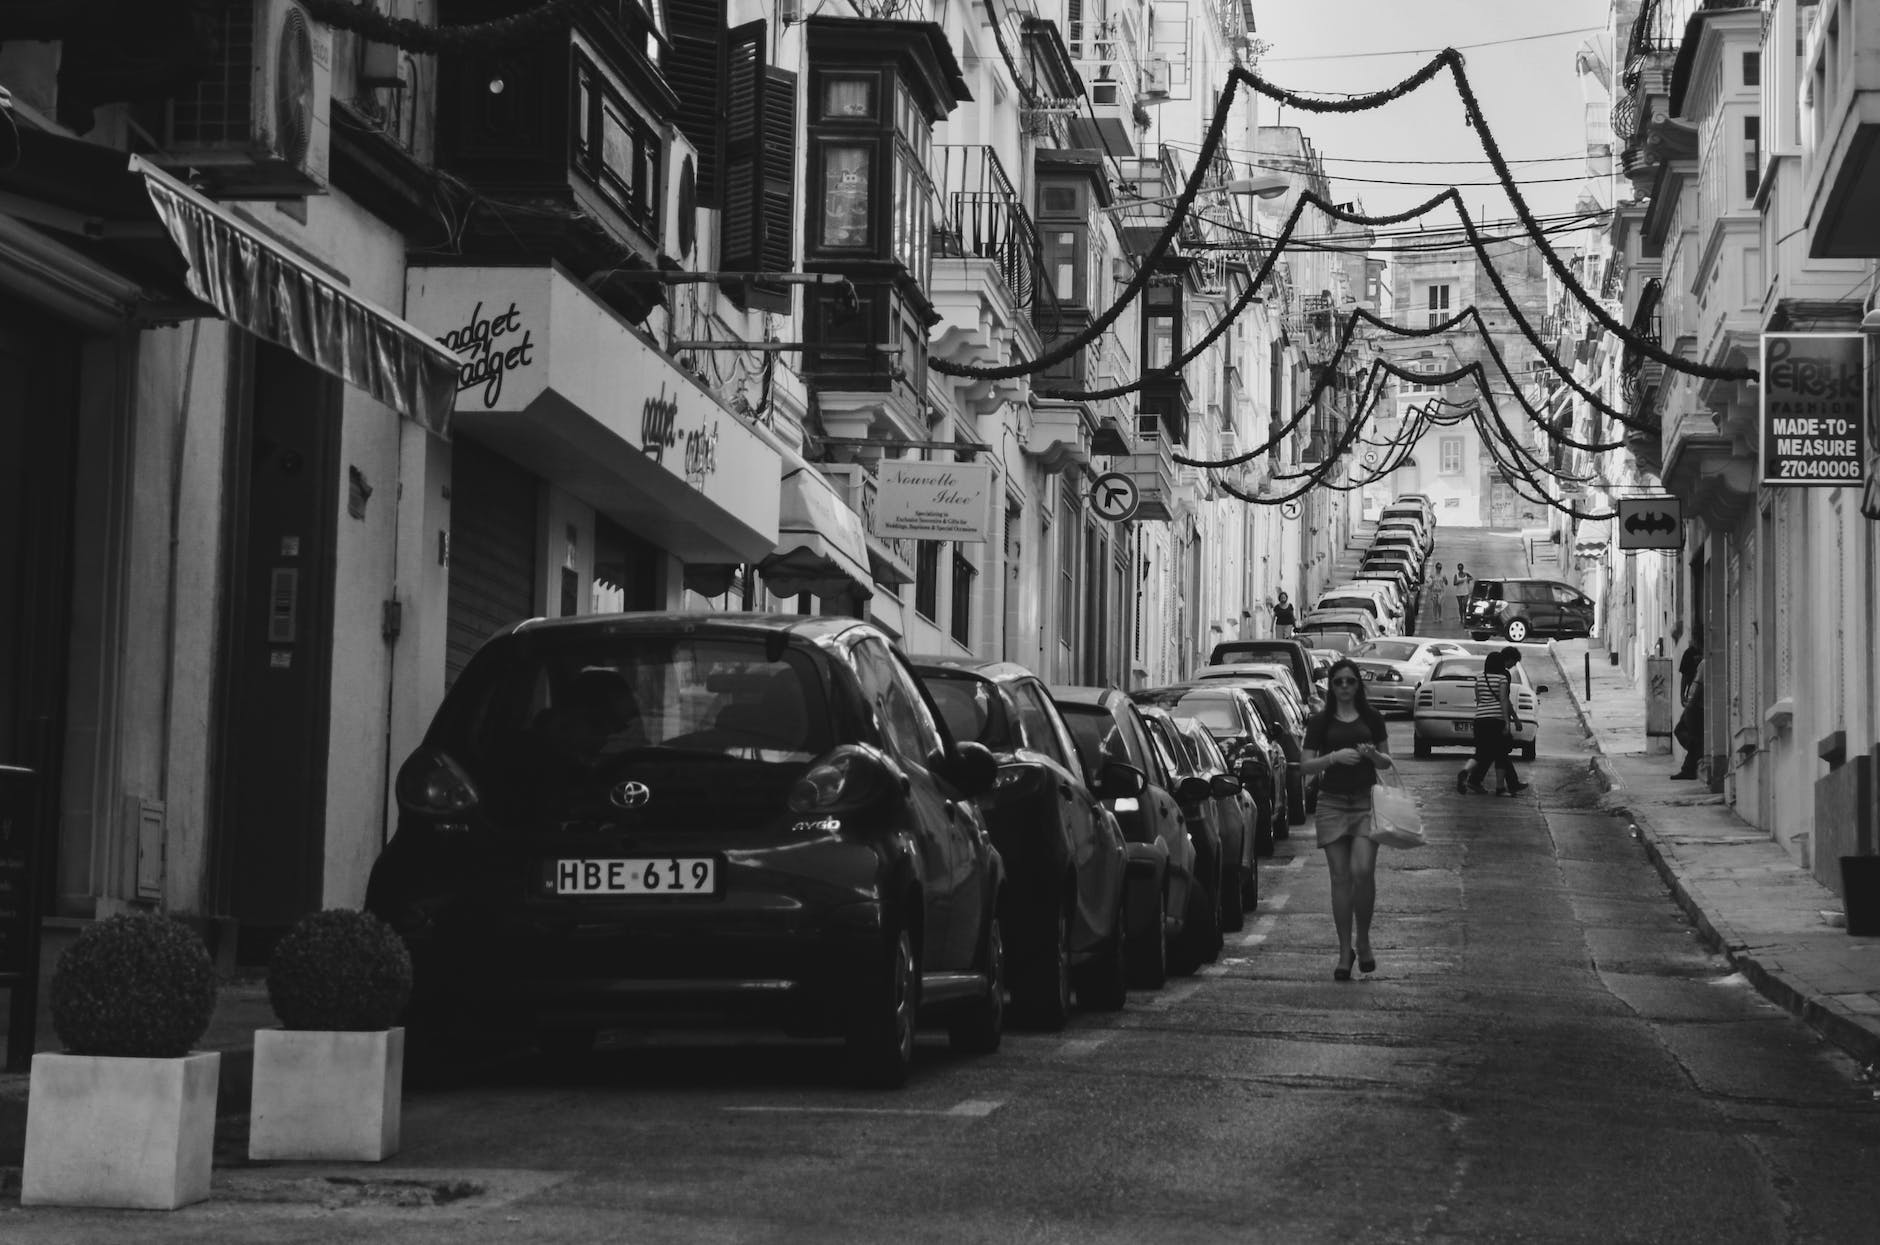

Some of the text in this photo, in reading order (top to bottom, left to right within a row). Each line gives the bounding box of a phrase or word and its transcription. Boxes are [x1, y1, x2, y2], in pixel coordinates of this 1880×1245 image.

[457, 330, 534, 409] adget
[1771, 402, 1857, 415] FASHION
[1773, 418, 1856, 435] MADE-TO-
[1777, 438, 1857, 456] MEASURE
[1780, 460, 1860, 477] 27040006
[886, 471, 957, 486] Nouvelle
[792, 820, 841, 830] AYGO
[560, 862, 625, 890] HBE
[643, 862, 708, 889] 619
